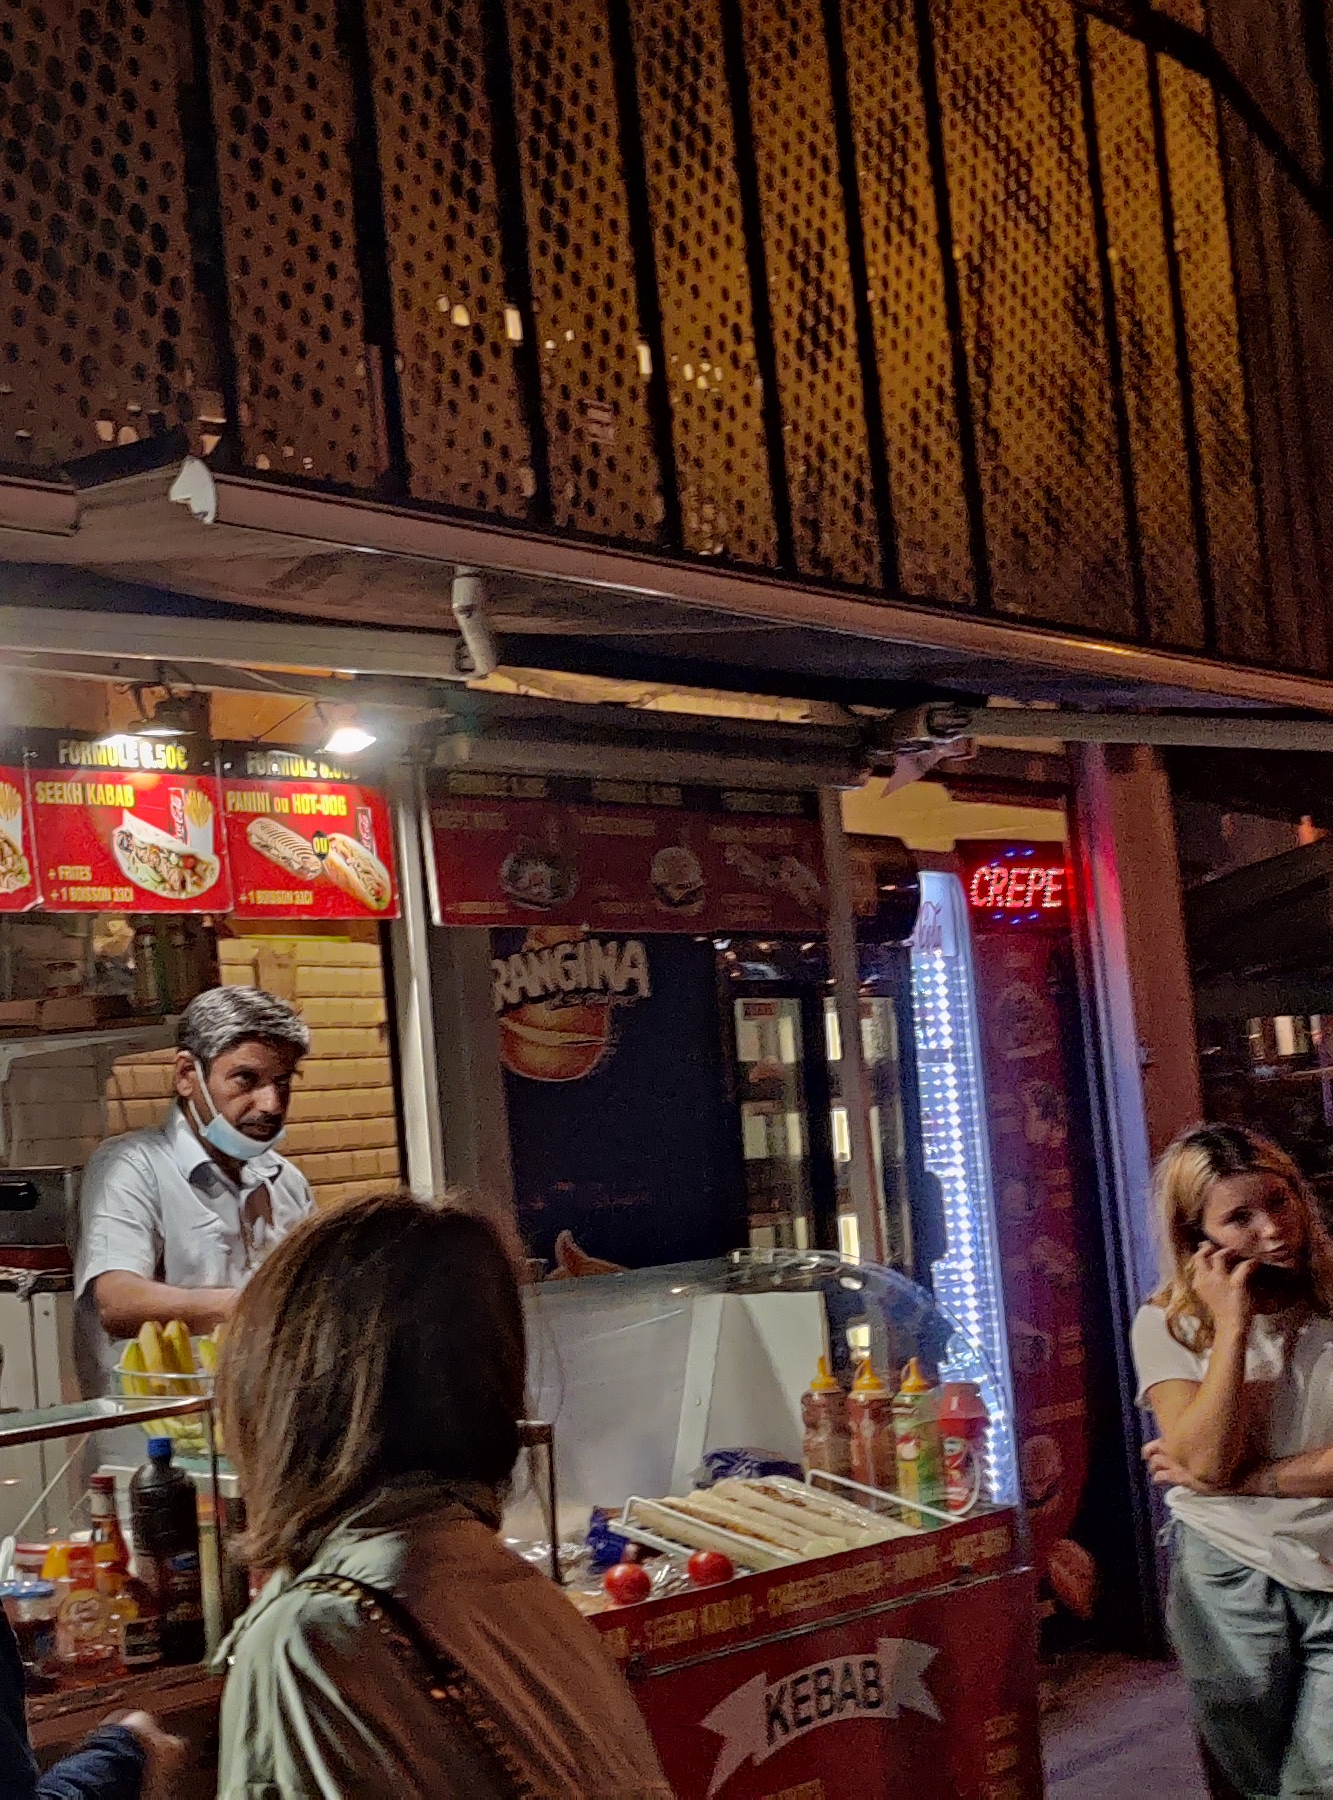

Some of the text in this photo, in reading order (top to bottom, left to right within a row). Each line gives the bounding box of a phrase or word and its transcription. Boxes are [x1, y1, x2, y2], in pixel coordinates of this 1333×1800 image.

[59, 740, 138, 768] FORMULE
[36, 781, 135, 807] SEEKH KABAB
[226, 790, 270, 813] PANINI
[292, 793, 347, 816] HOT-DOG
[58, 866, 92, 881] FRITES
[69, 887, 111, 902] BOISSON
[969, 866, 1065, 908] CREPE
[764, 1659, 882, 1746] KEBAB
